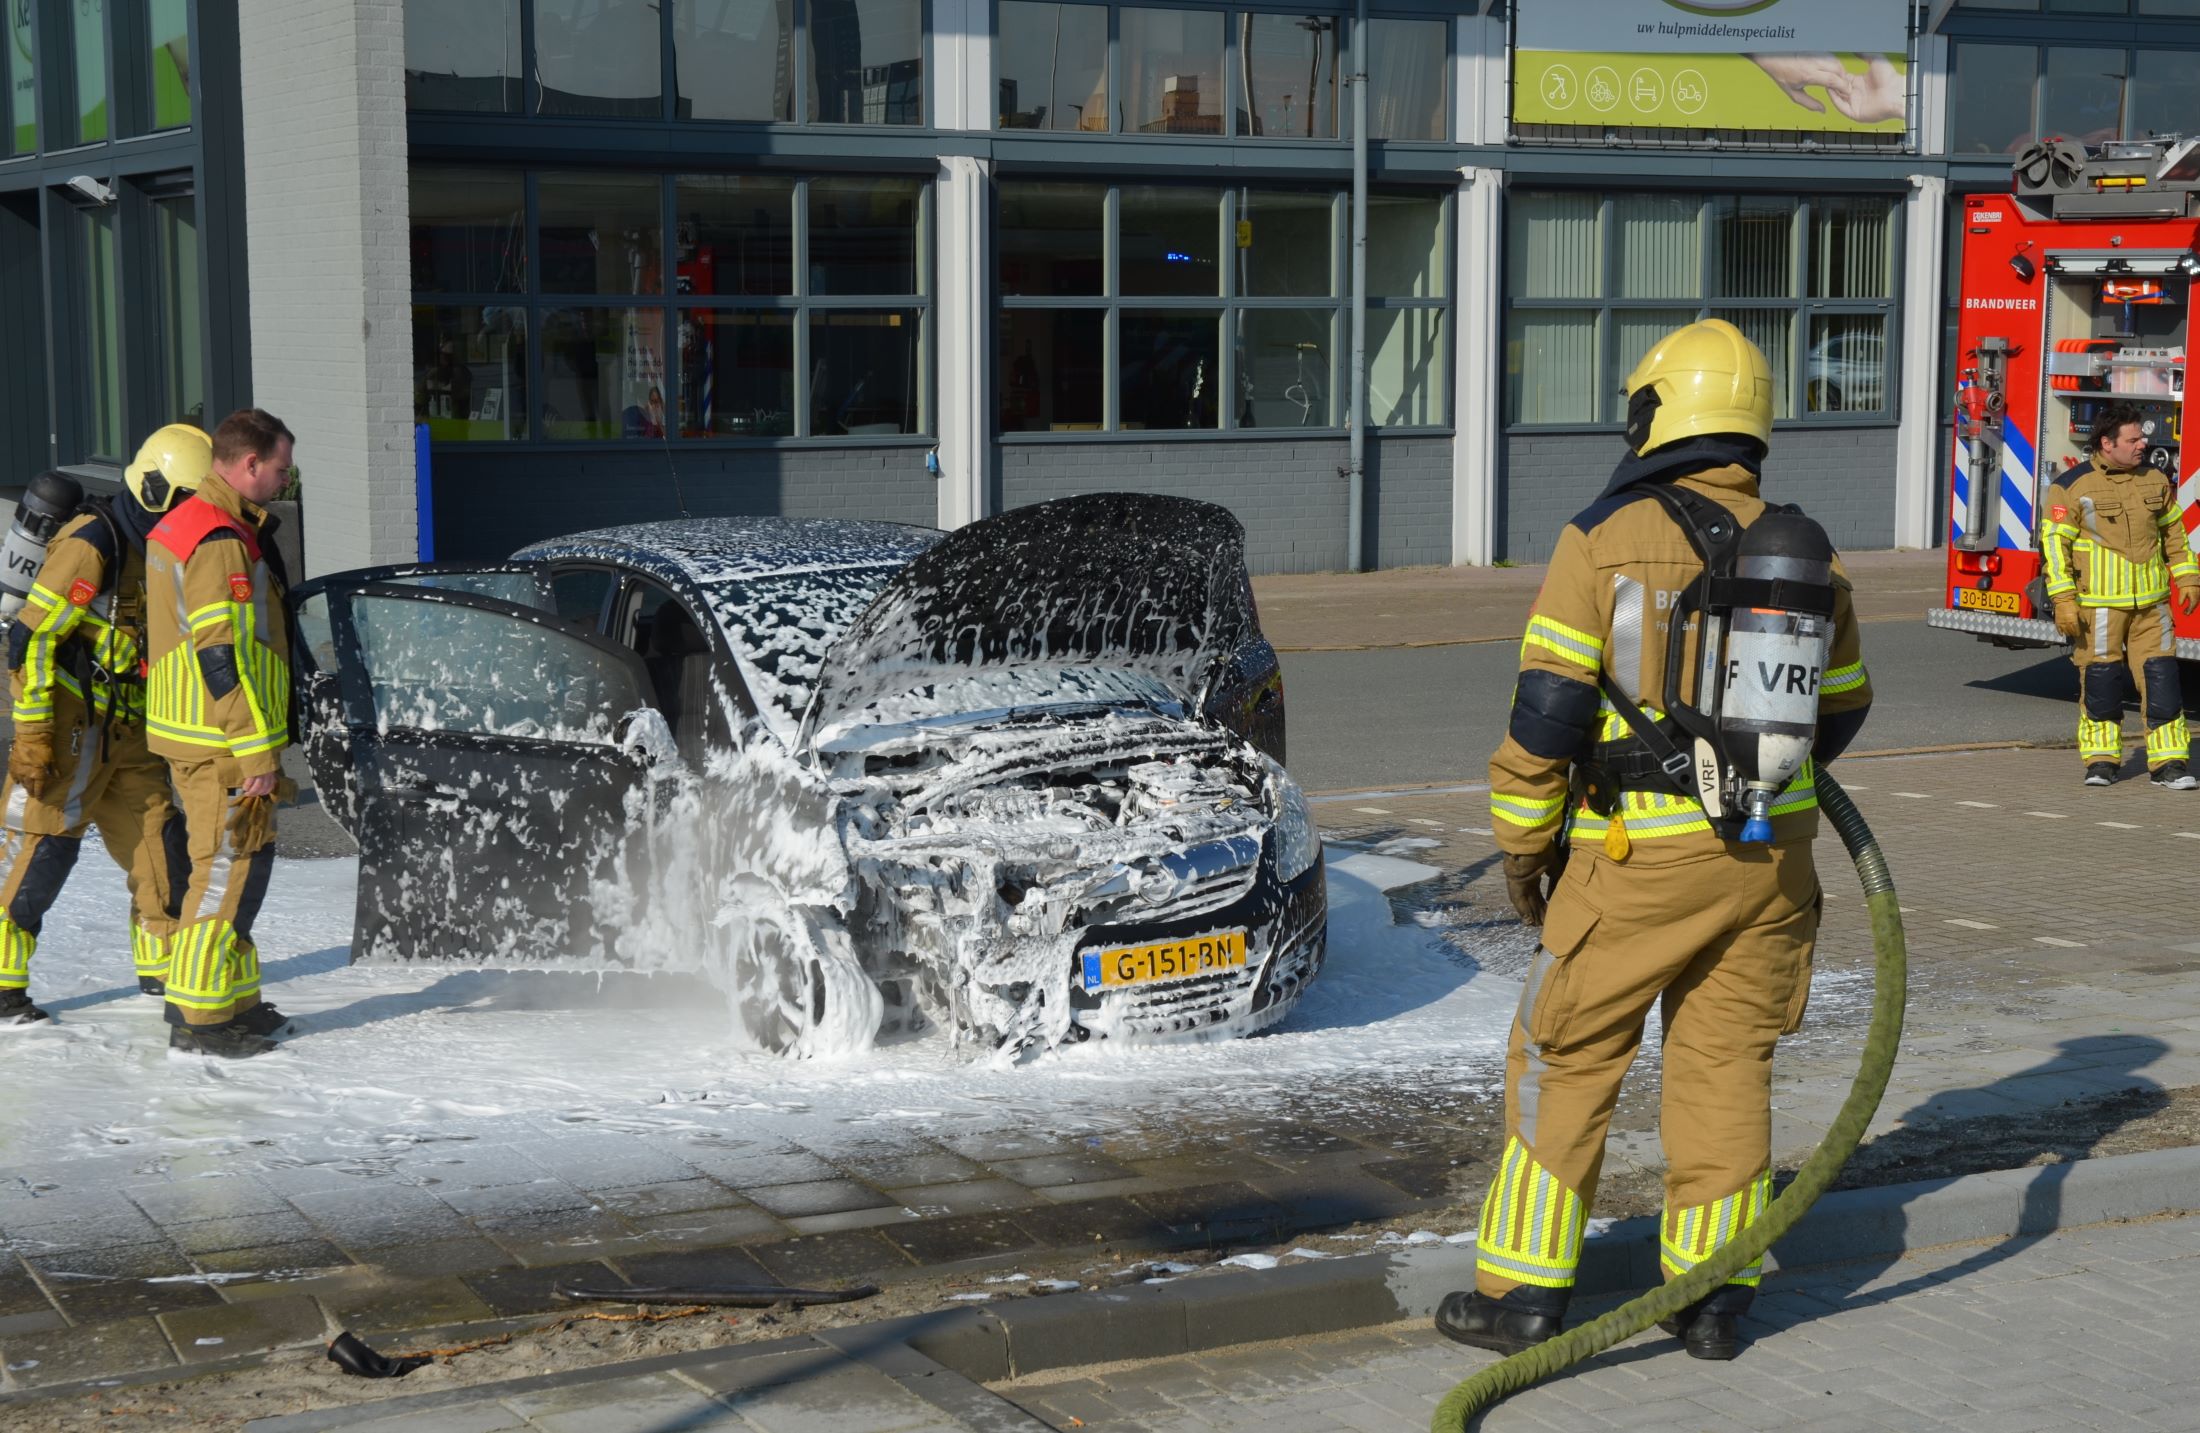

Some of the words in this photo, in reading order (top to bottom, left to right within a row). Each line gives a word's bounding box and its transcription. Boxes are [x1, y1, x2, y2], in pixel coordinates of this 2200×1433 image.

[1637, 23, 1655, 33] uw
[1658, 21, 1796, 41] hulpmiddelenspecialist
[1966, 298, 2037, 310] BRANDWEER
[1962, 591, 2015, 610] 30-BLD-2
[1758, 661, 1820, 696] VRF
[1702, 758, 1715, 793] VRF
[1117, 938, 1233, 981] G-151-BN
[1087, 975, 1100, 985] NL
